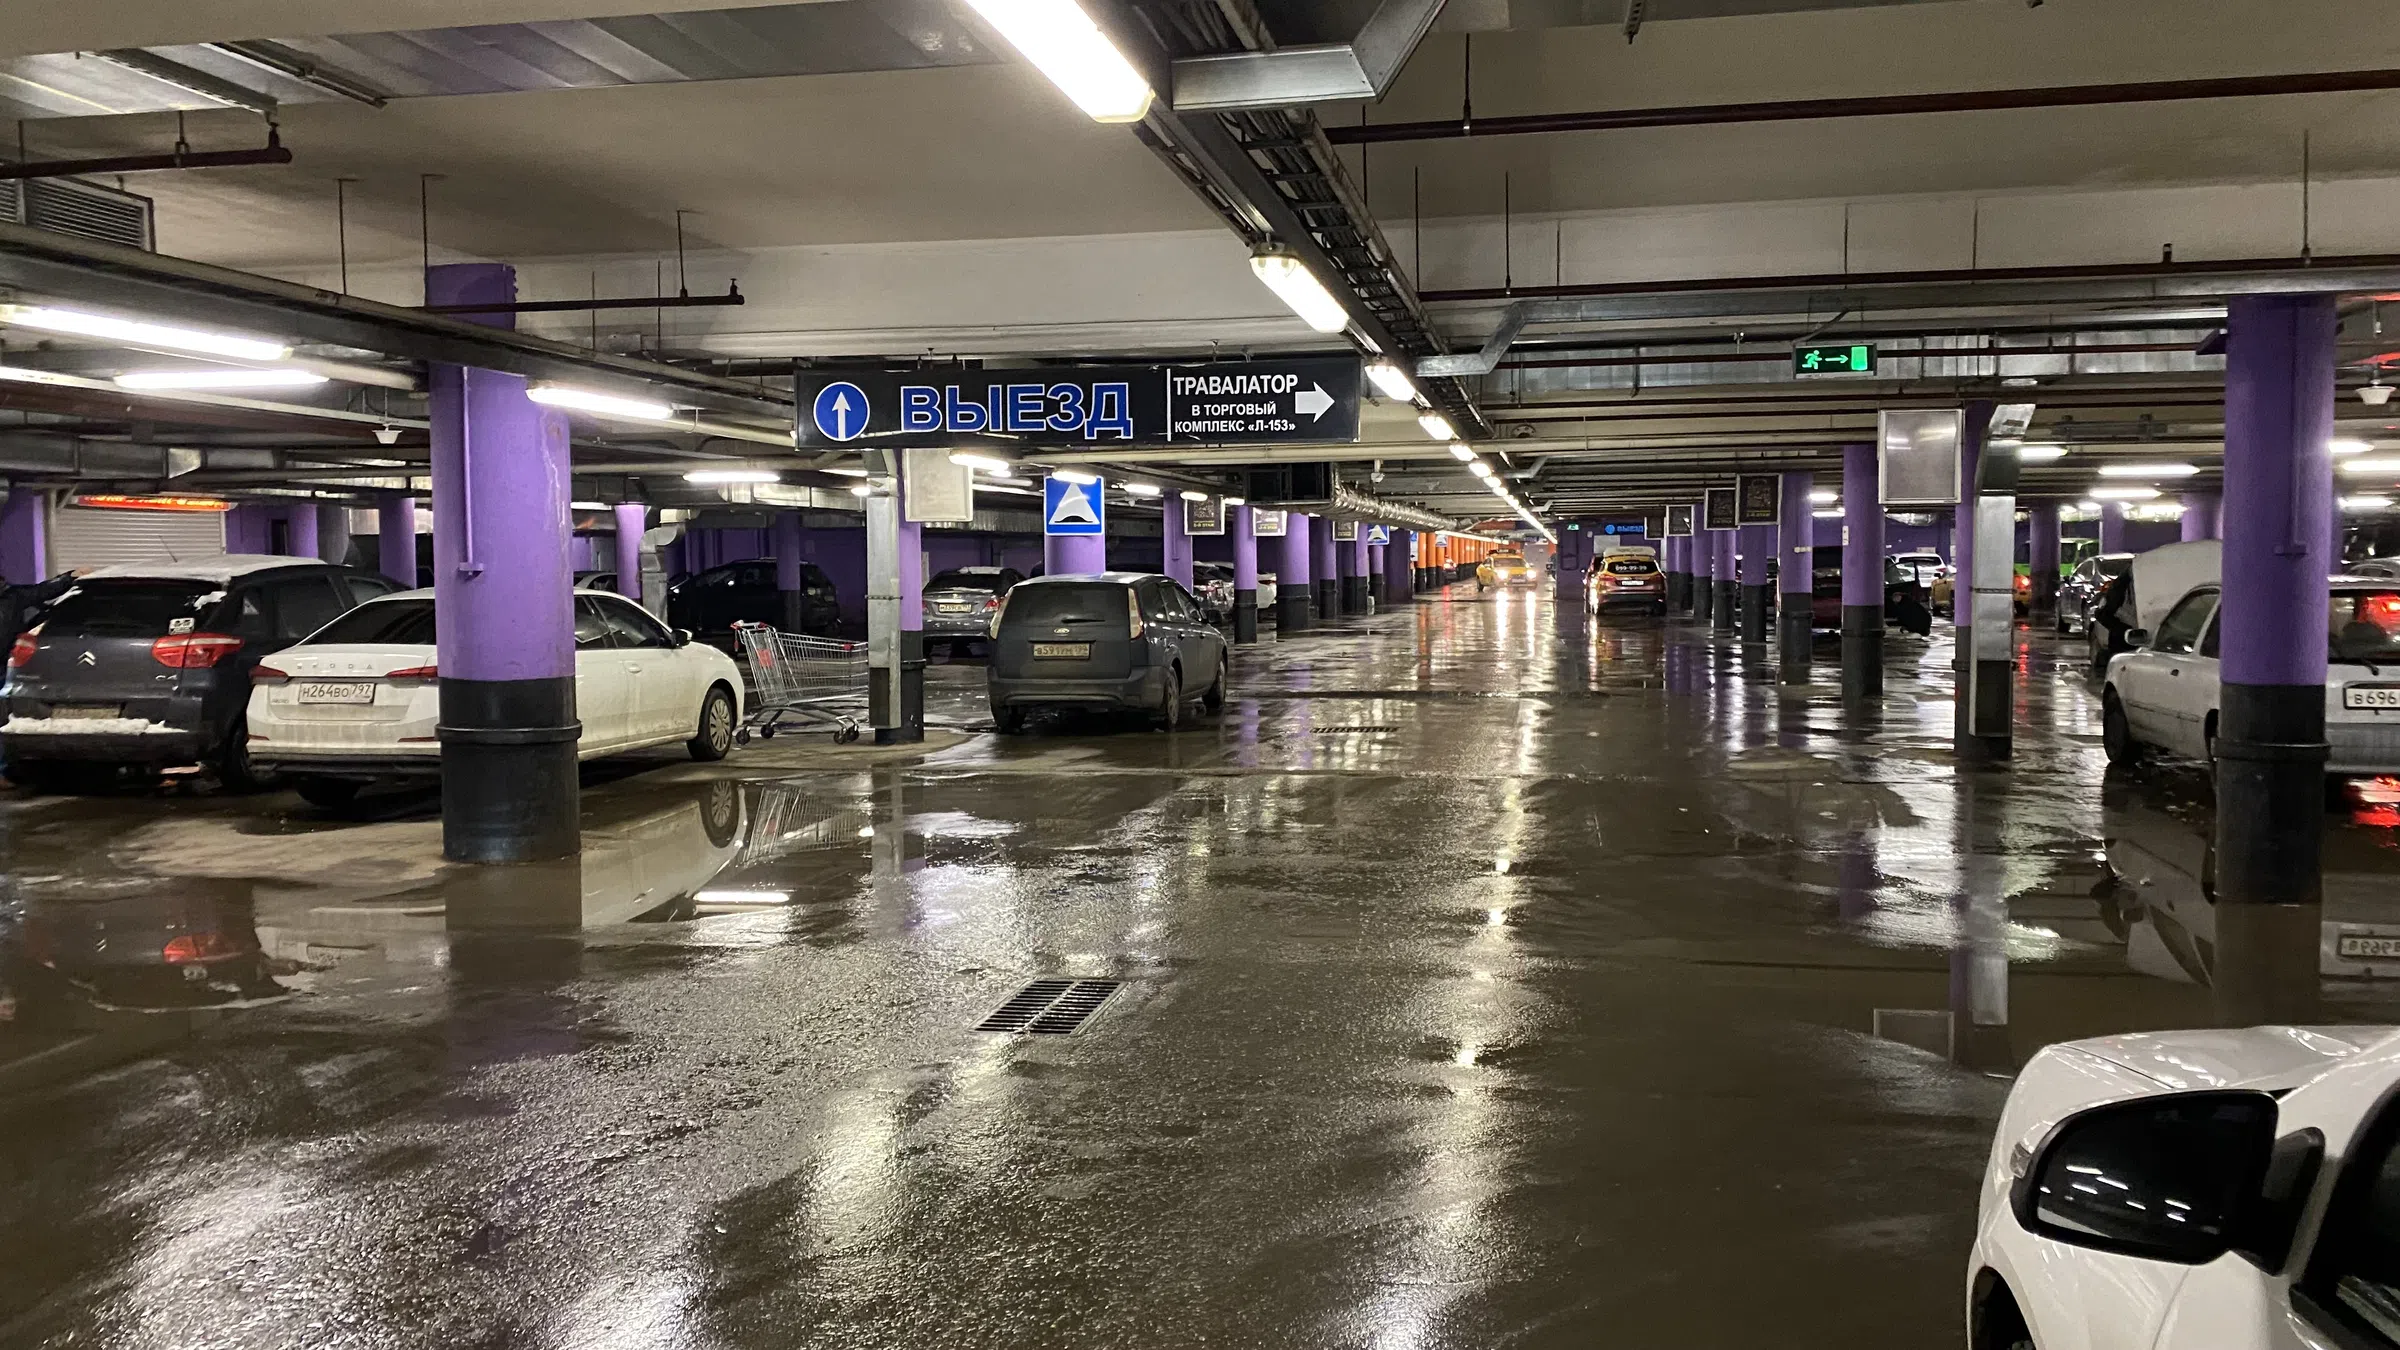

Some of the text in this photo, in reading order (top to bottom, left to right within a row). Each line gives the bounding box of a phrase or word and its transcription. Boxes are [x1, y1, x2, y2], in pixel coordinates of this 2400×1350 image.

[1173, 374, 1298, 395] ТРАВАЛАТОР
[900, 382, 1133, 439] ВЫЕЗД
[1204, 401, 1276, 416] ТОРГОВЫЙ
[1175, 420, 1296, 433] КОМПЛЕКС «Л-153»
